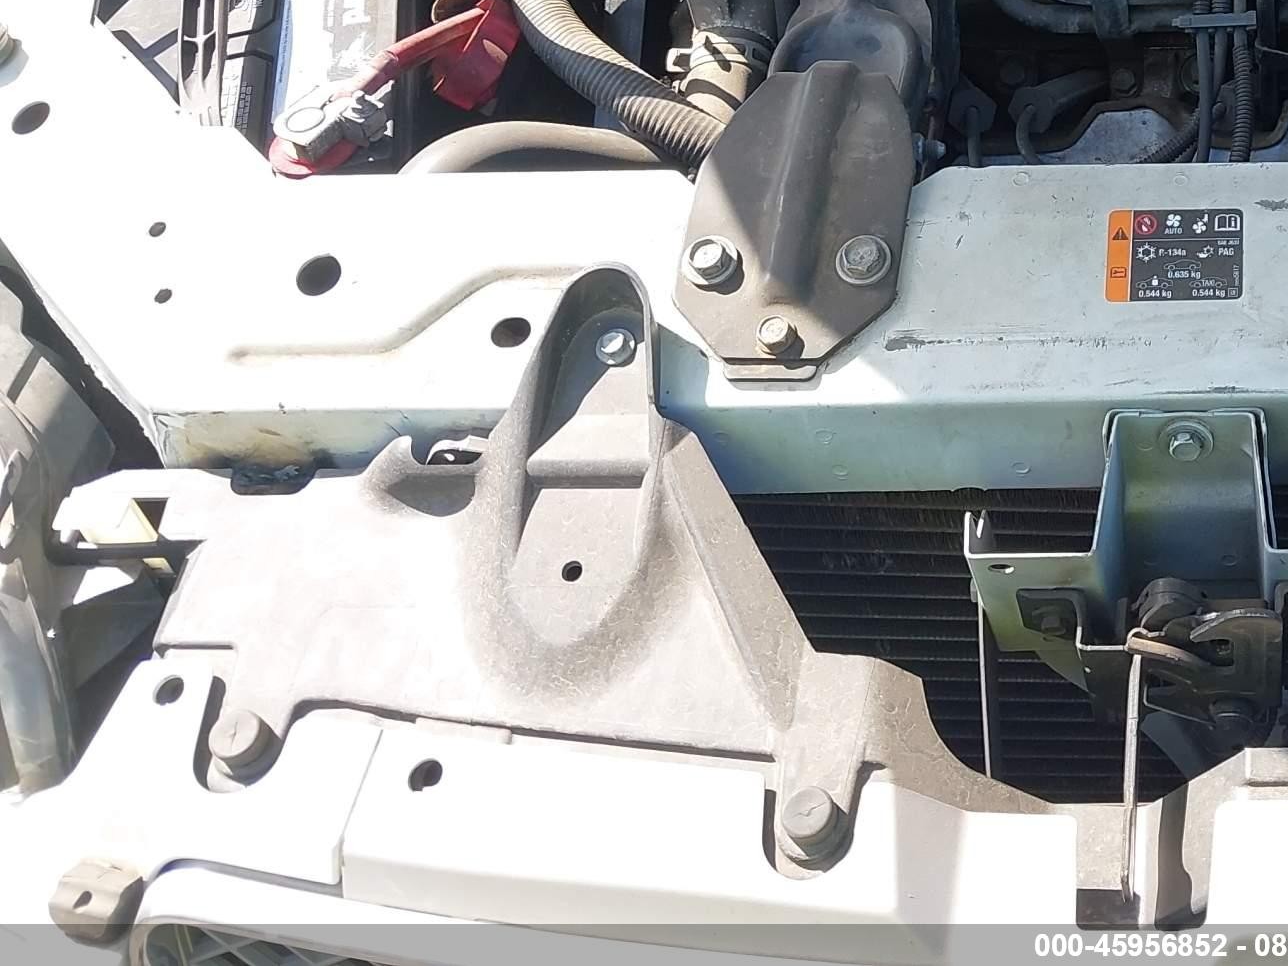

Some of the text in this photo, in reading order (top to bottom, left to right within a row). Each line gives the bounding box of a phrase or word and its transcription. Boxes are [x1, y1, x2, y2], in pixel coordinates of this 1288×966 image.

[1164, 227, 1183, 235] AUTO
[1158, 248, 1187, 256] R-134a
[1218, 248, 1234, 256] PAG
[1167, 270, 1201, 279] 0.635 kg
[1138, 289, 1172, 298] 0.544 kg
[1192, 288, 1226, 298] 0.544 kg
